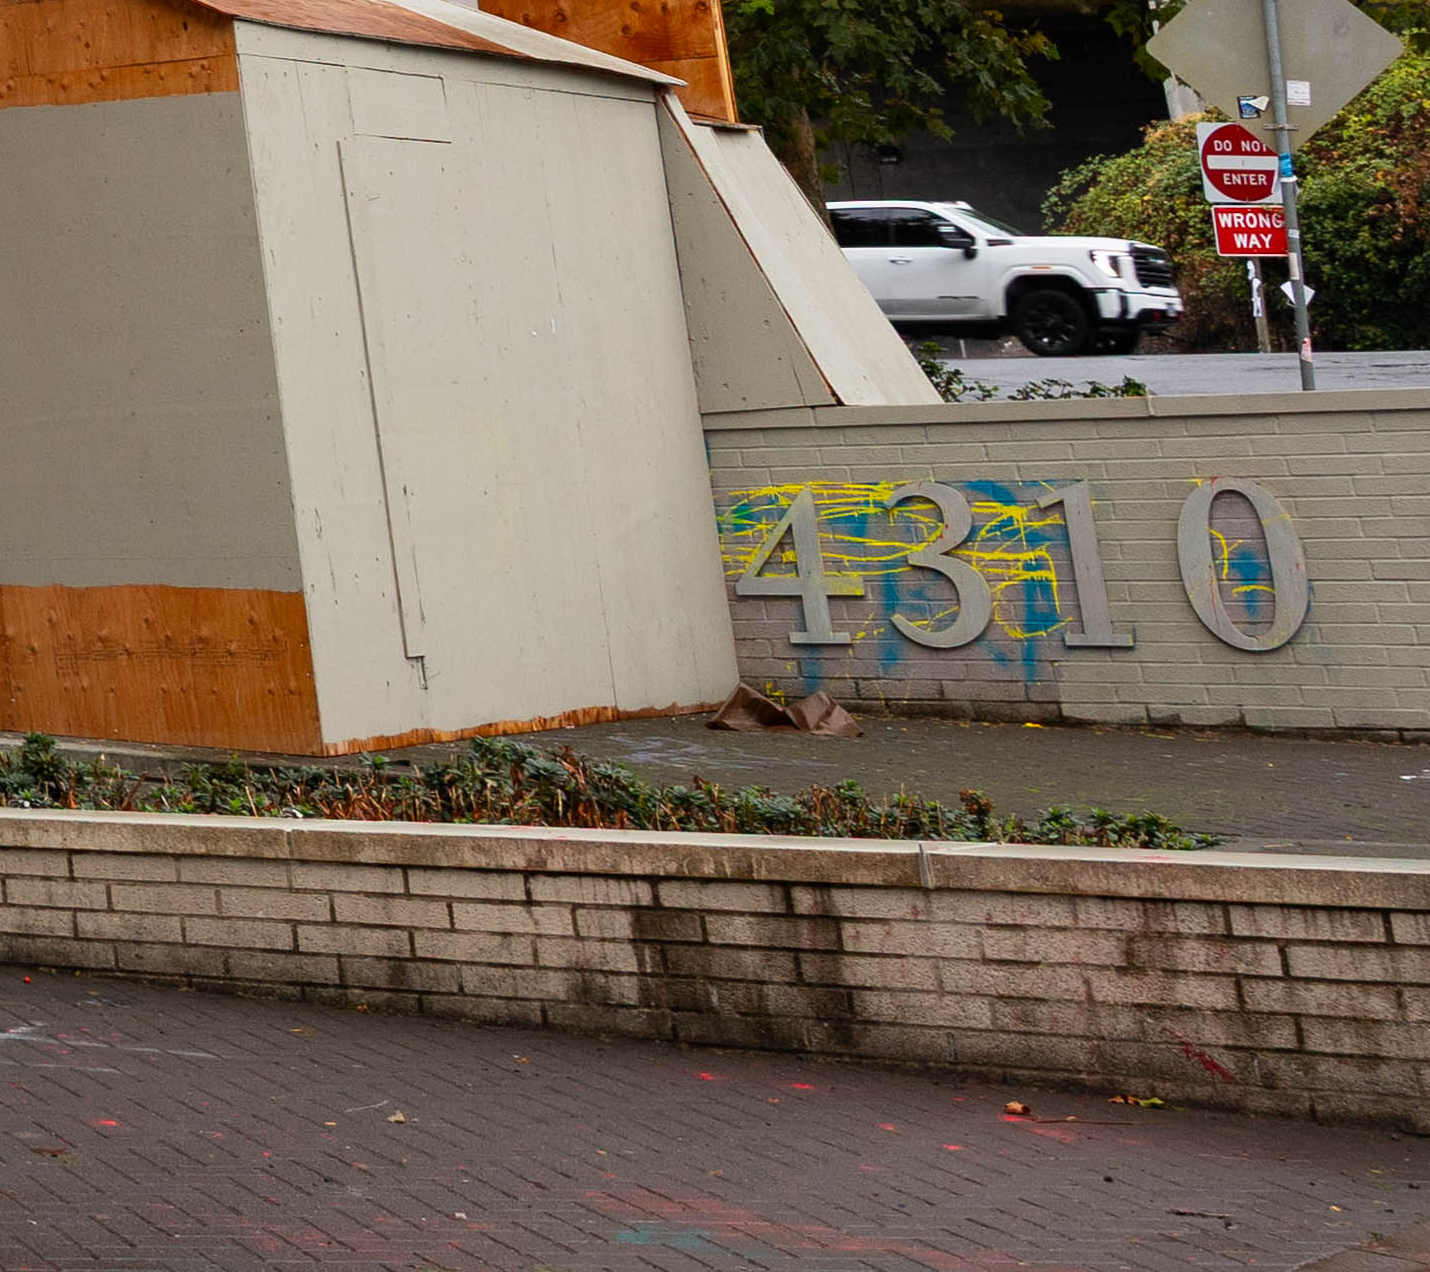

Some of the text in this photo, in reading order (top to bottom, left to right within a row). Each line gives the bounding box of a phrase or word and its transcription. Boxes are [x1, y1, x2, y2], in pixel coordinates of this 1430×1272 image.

[1213, 139, 1233, 152] DO
[1223, 173, 1267, 186] ENTER
[1218, 212, 1284, 229] WRONG
[1233, 233, 1273, 249] WAY
[736, 477, 1310, 652] 4310
